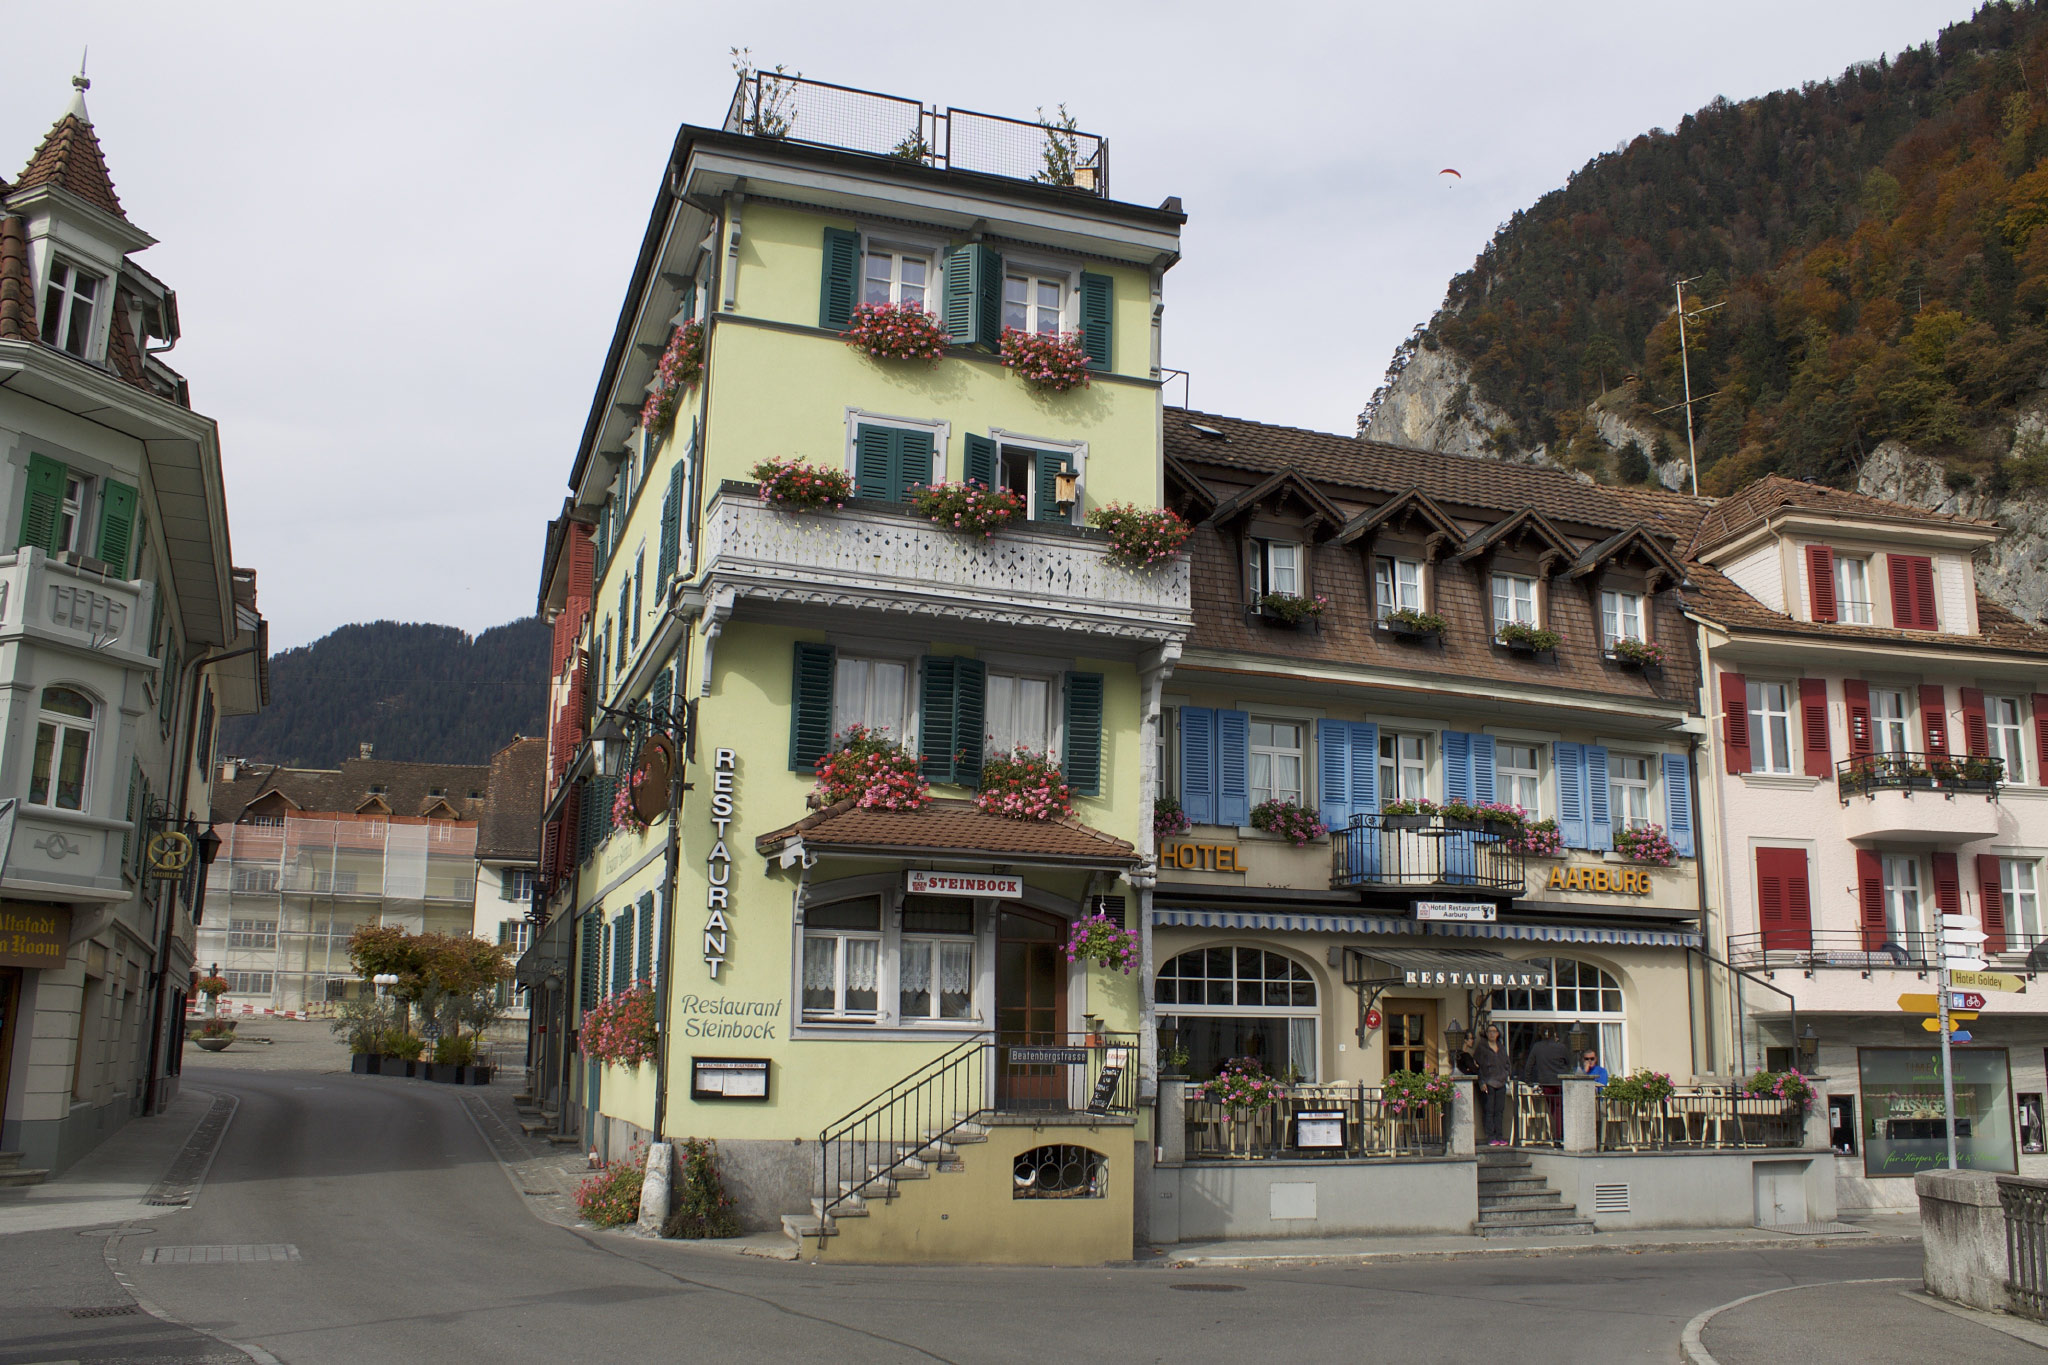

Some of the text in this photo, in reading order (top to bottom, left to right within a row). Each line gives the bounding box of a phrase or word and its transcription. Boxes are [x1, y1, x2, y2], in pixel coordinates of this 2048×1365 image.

[703, 747, 736, 979] RESTAURANT
[1160, 842, 1248, 871] HOTEL
[929, 877, 1017, 892] STEINBOCK
[1549, 865, 1652, 893] AARBURG
[1443, 911, 1467, 919] Aarburg
[1449, 904, 1480, 912] Restaurant
[1406, 971, 1545, 985] RESTAURANT
[1956, 972, 2002, 990] Hotel Goldey
[682, 994, 783, 1016] Restaurant
[685, 1018, 776, 1039] Steinbock
[1012, 1050, 1086, 1062] Beatenbergstrasse
[1890, 1099, 1947, 1113] MASSAGE
